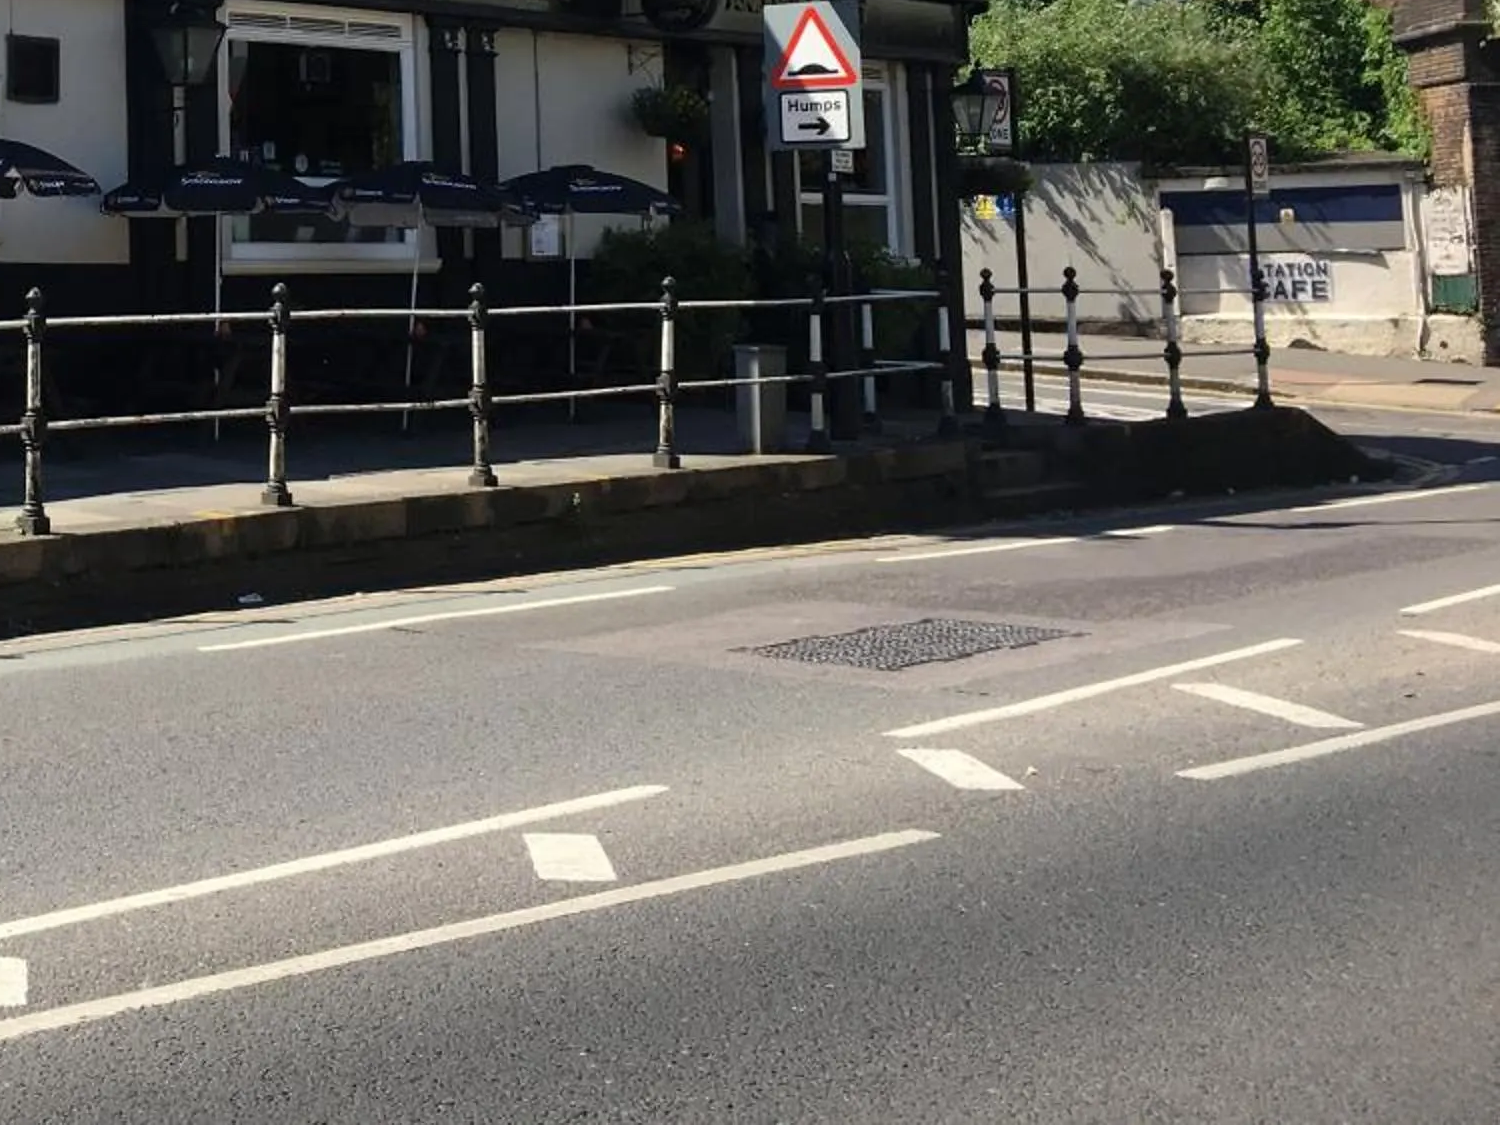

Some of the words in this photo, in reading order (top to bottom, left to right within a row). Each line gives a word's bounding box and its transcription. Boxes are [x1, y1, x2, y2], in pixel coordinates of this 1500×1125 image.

[787, 99, 842, 116] Humps
[990, 128, 1009, 140] ONE
[1262, 262, 1328, 278] TATION
